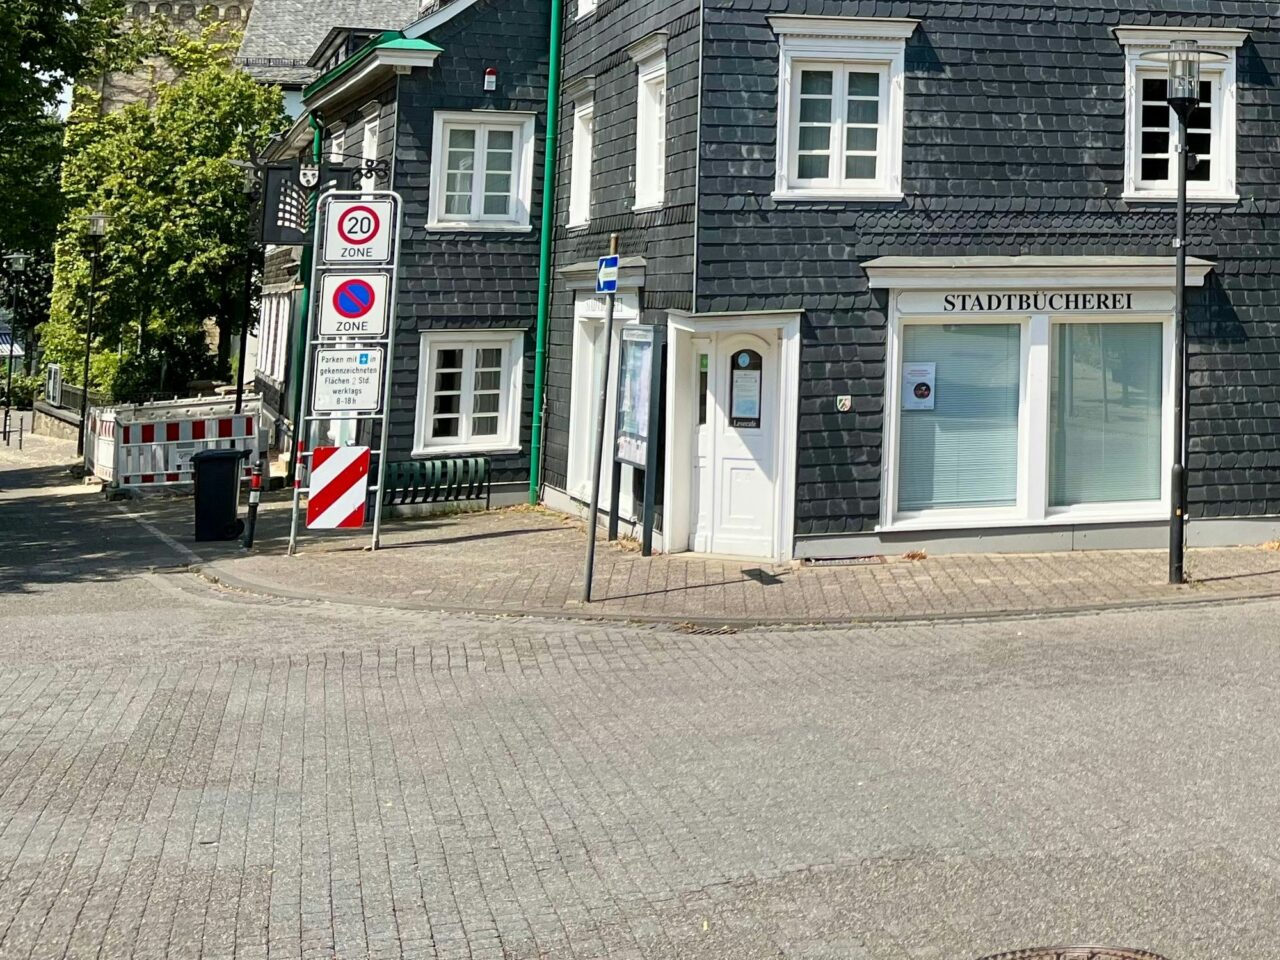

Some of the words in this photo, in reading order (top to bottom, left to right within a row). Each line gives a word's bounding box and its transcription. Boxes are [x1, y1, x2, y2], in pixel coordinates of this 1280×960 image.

[346, 216, 372, 234] 20
[341, 247, 373, 258] ZONE
[943, 290, 1133, 312] STADTBÜCHEREI
[336, 321, 368, 331] ZONE
[346, 355, 357, 363] mit
[320, 367, 377, 376] gekennzeichneten
[324, 376, 350, 385] Flächen
[352, 377, 357, 385] 2
[332, 387, 362, 396] werktags
